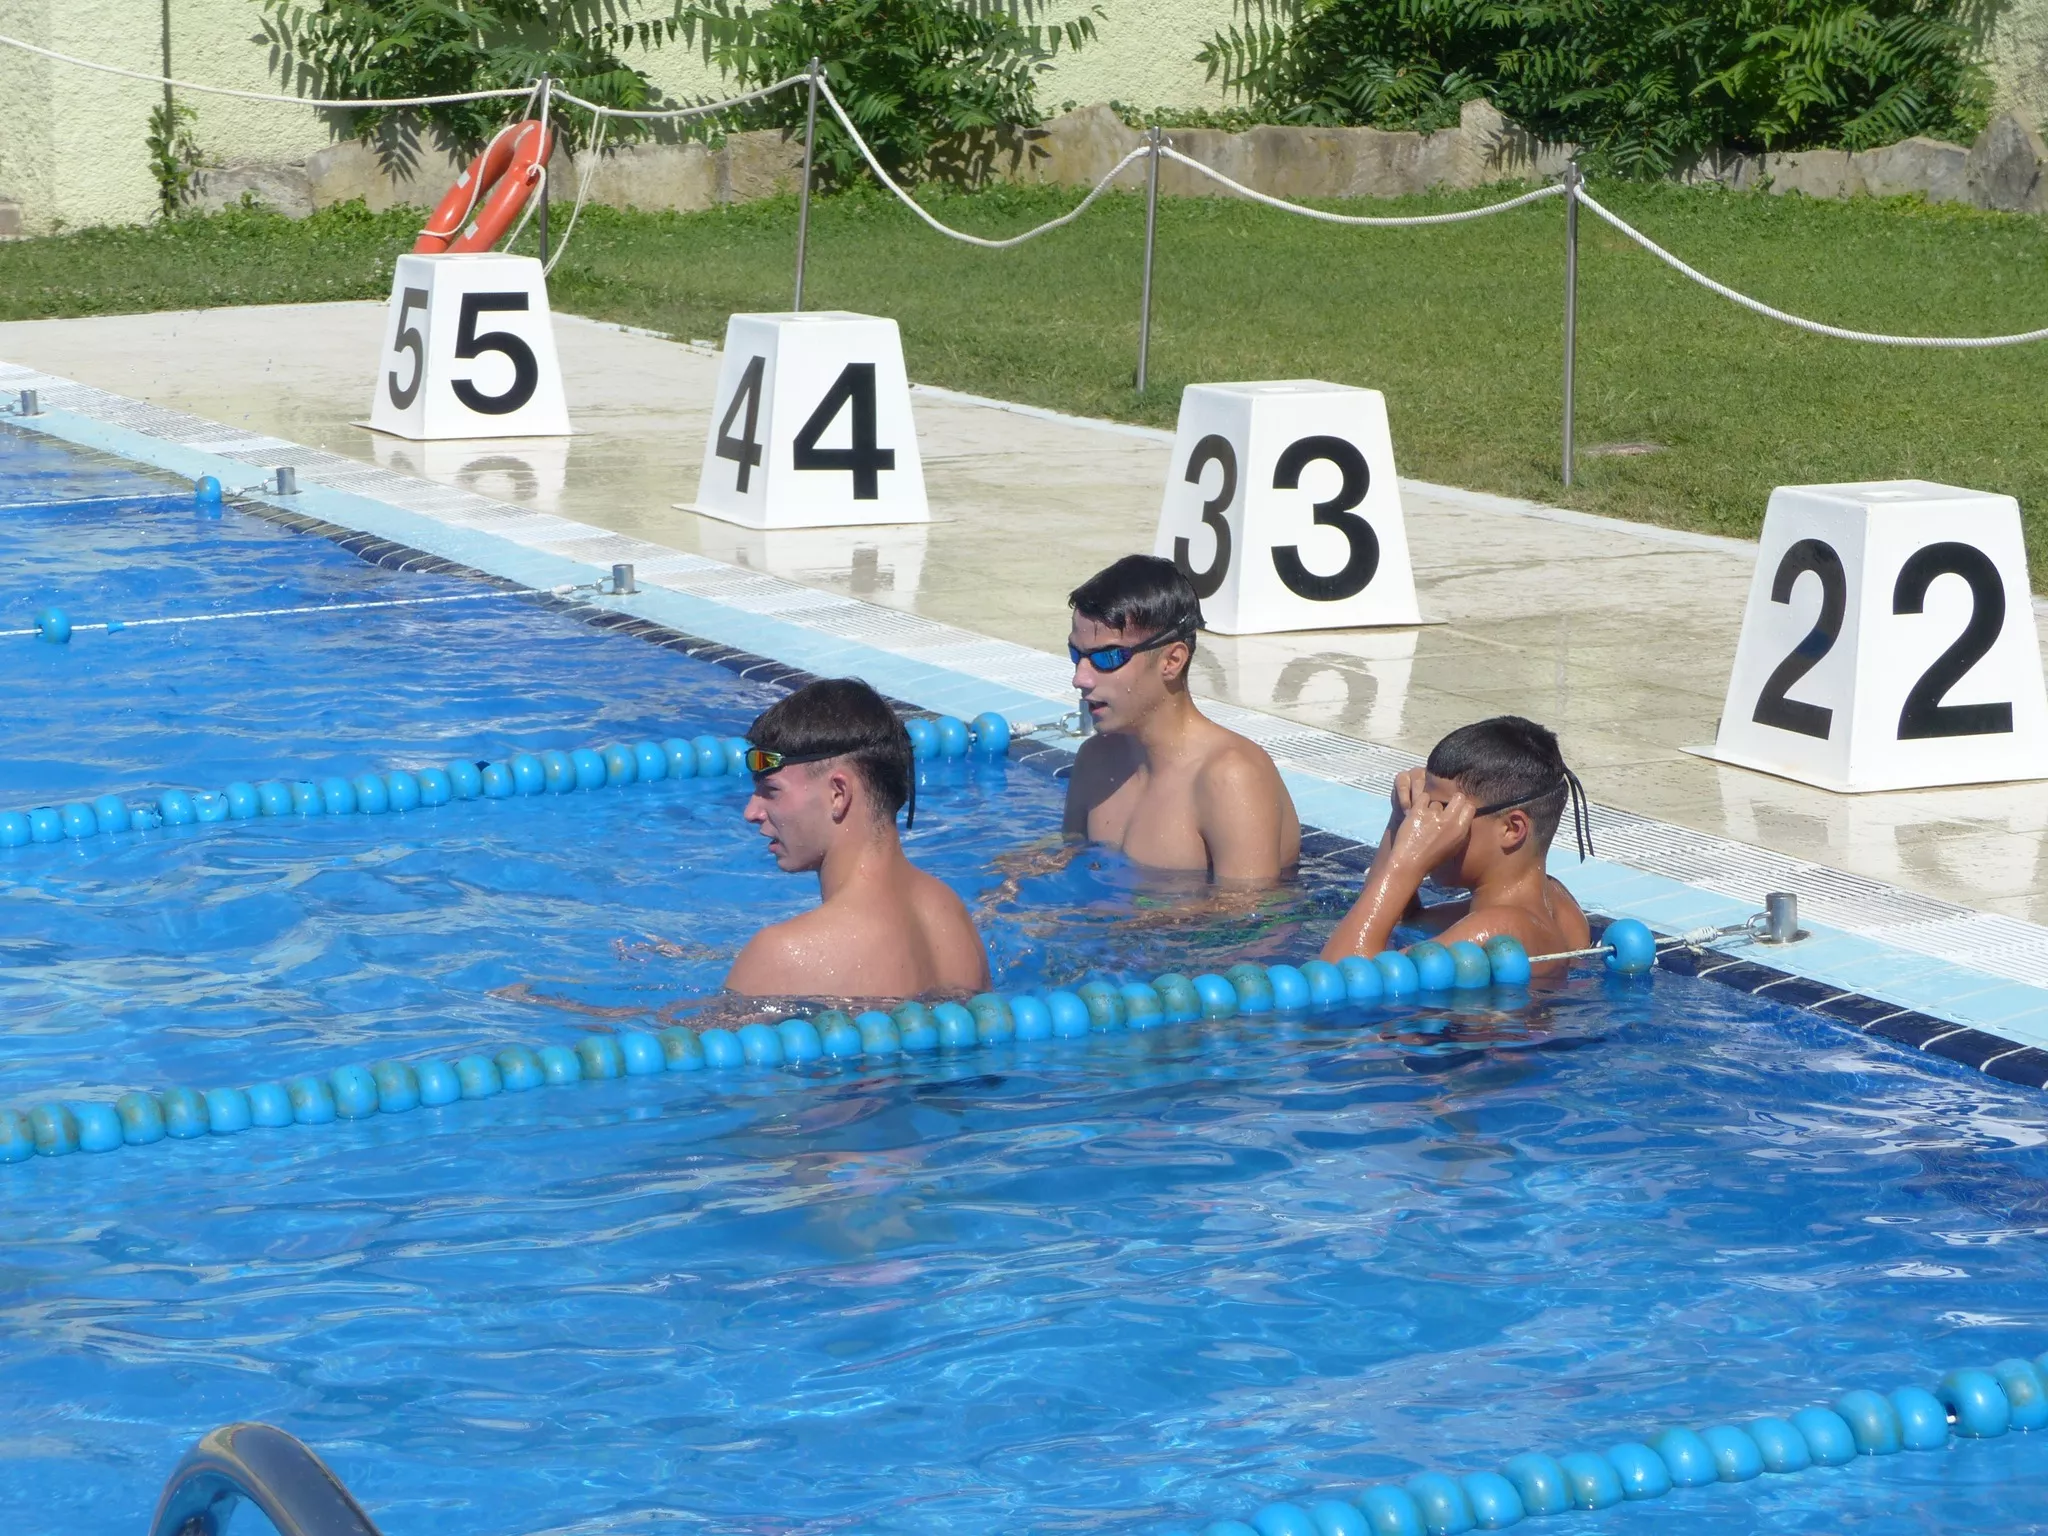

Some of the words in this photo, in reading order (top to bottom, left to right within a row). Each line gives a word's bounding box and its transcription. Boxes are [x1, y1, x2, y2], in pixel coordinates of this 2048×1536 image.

[388, 287, 430, 411] 5
[450, 291, 539, 415] 5
[715, 355, 767, 494] 4
[793, 362, 896, 501] 4
[1174, 434, 1239, 600] 3
[1271, 435, 1381, 602] 3
[1752, 538, 1847, 741] 2
[1892, 541, 2014, 741] 2
